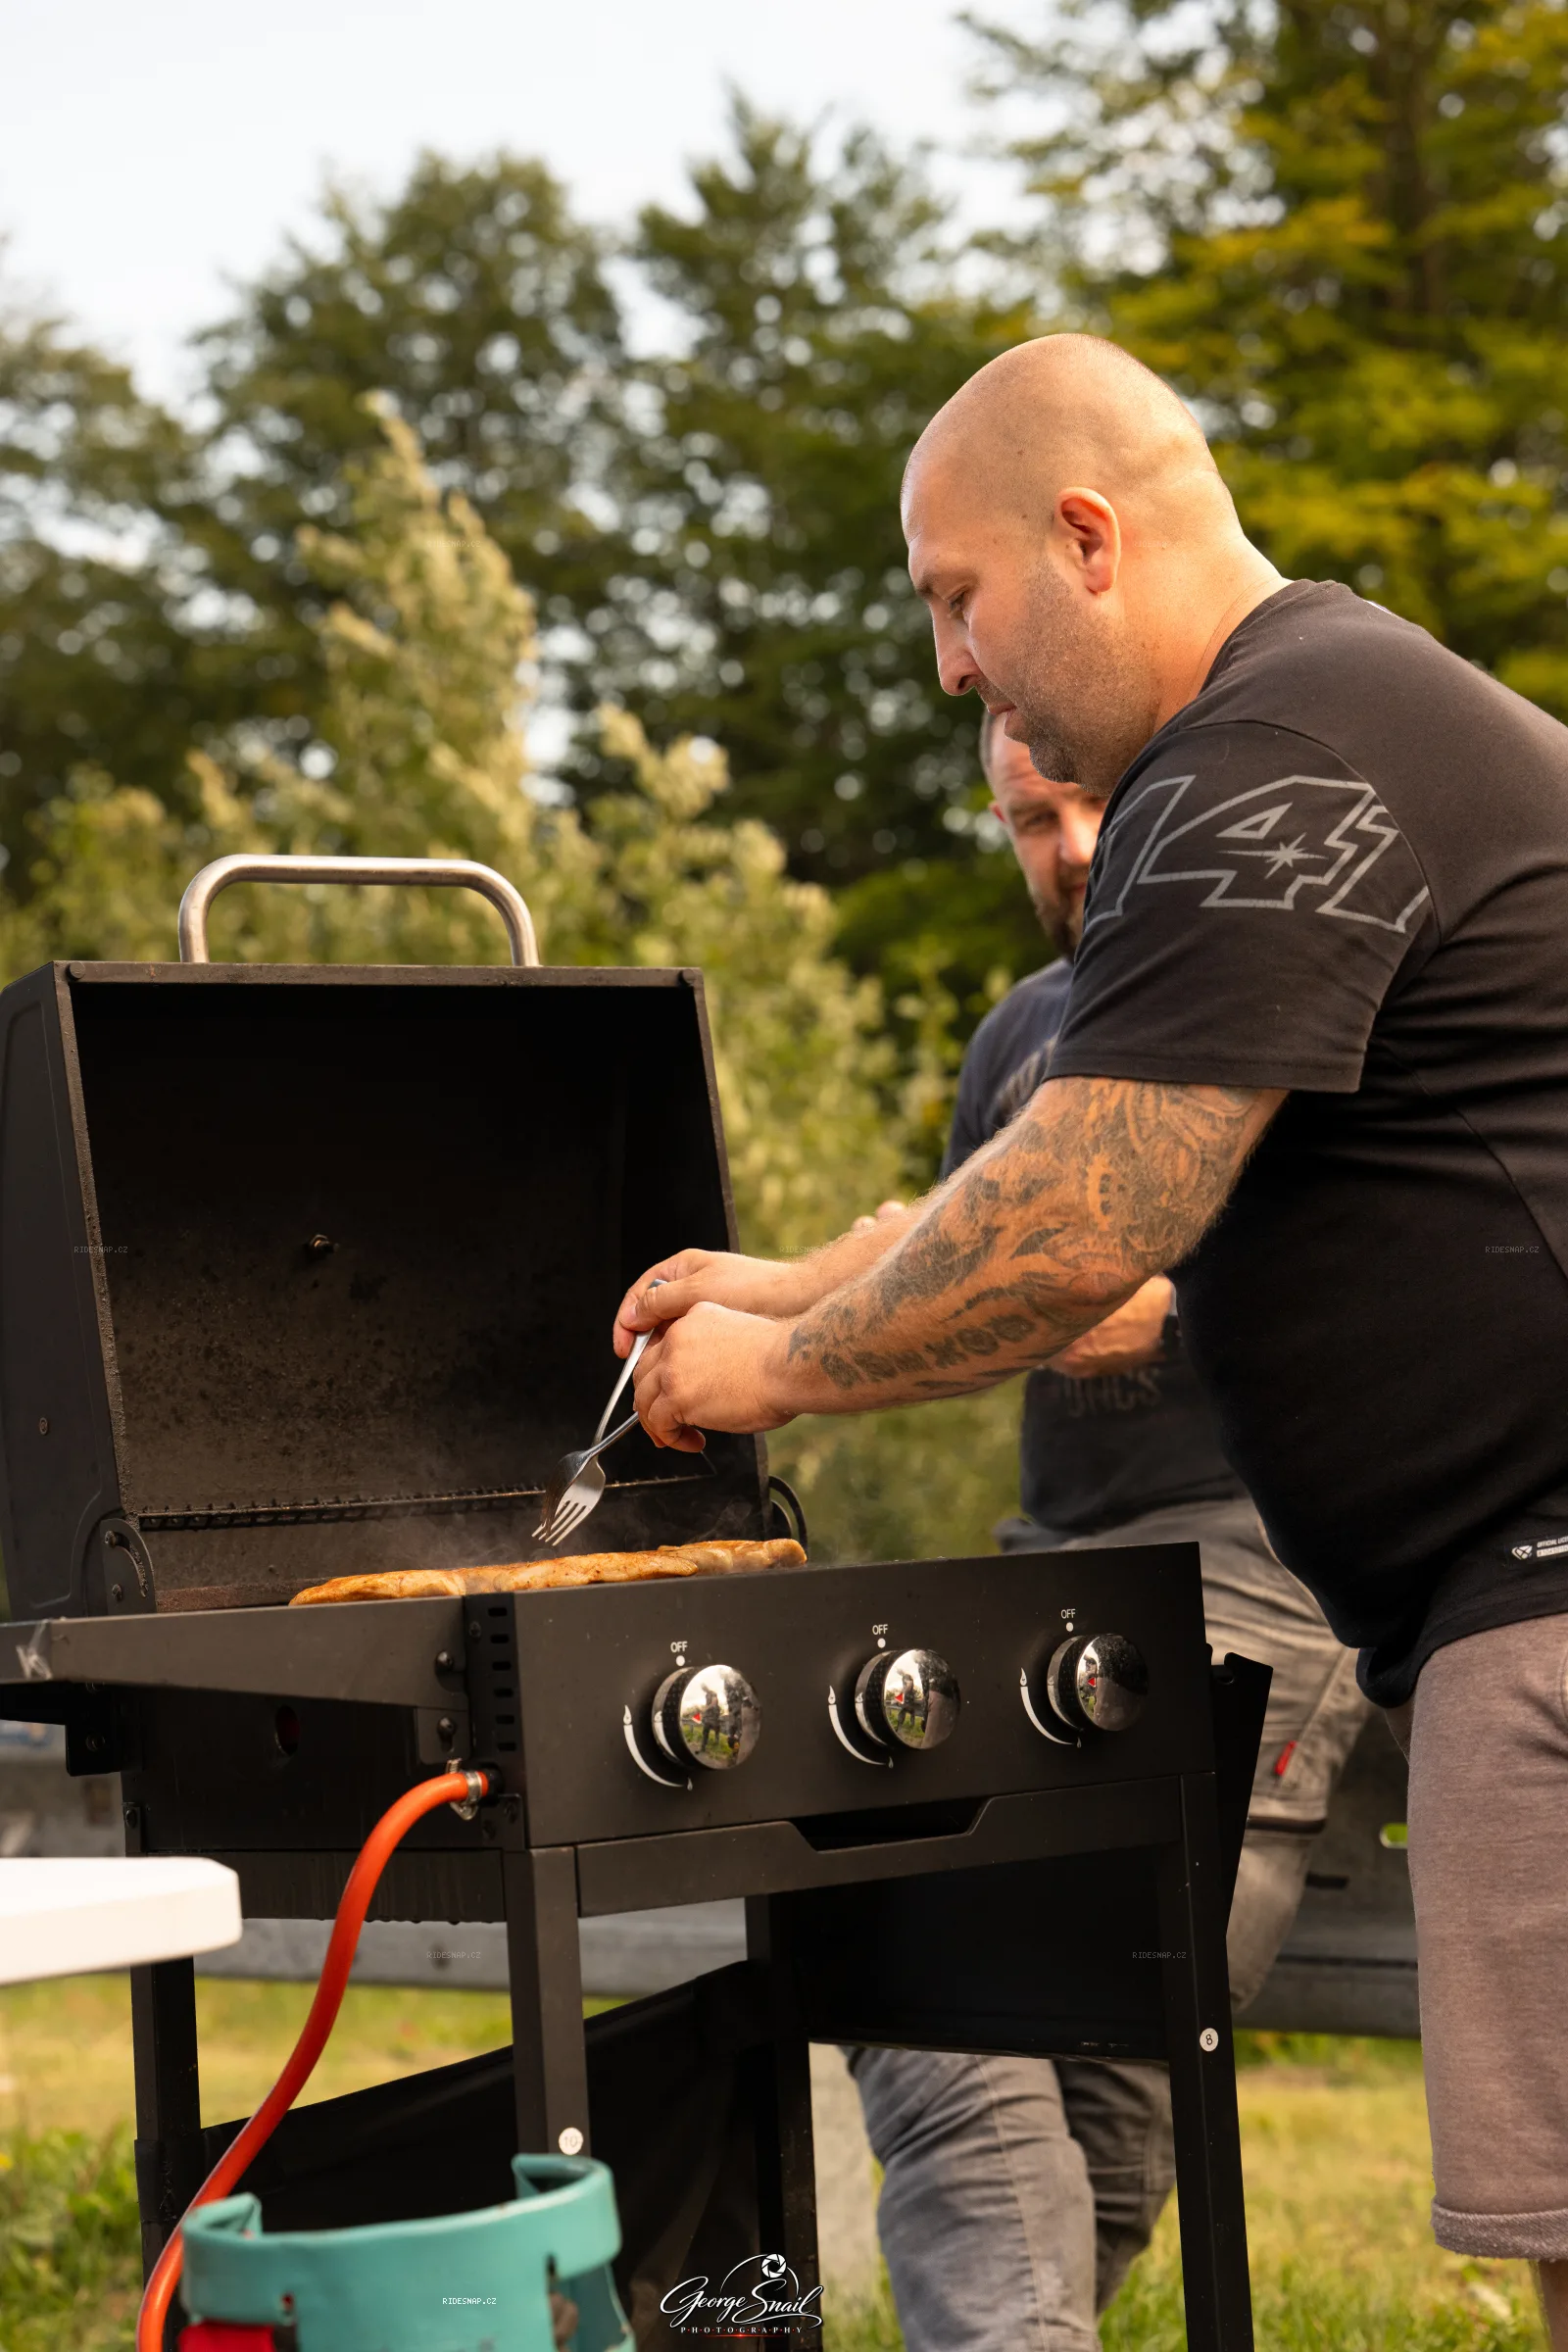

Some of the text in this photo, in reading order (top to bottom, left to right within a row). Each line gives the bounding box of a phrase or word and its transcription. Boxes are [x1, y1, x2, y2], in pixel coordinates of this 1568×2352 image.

[1060, 1608, 1076, 1620] OFF
[872, 1623, 889, 1636] OFF
[670, 1641, 688, 1653] OFF
[1205, 2034, 1213, 2046] 8
